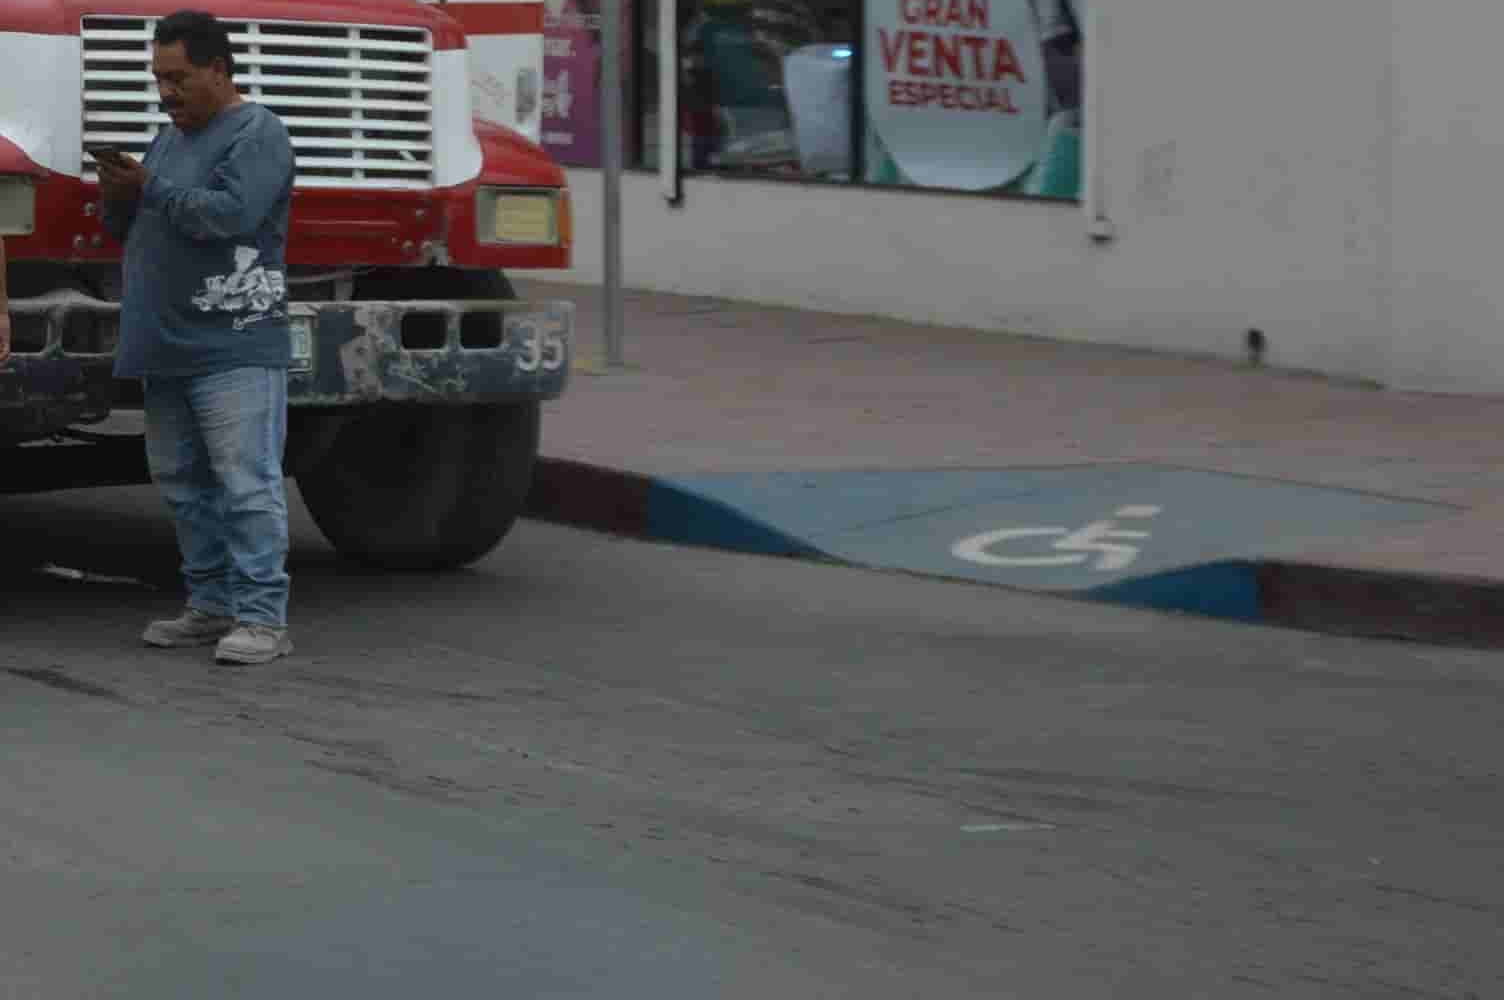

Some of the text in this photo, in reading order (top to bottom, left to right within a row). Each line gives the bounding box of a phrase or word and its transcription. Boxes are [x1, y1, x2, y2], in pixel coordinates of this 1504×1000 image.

[877, 27, 1026, 83] VENTA
[888, 79, 1023, 115] ESPECIAL
[517, 320, 565, 372] 35
